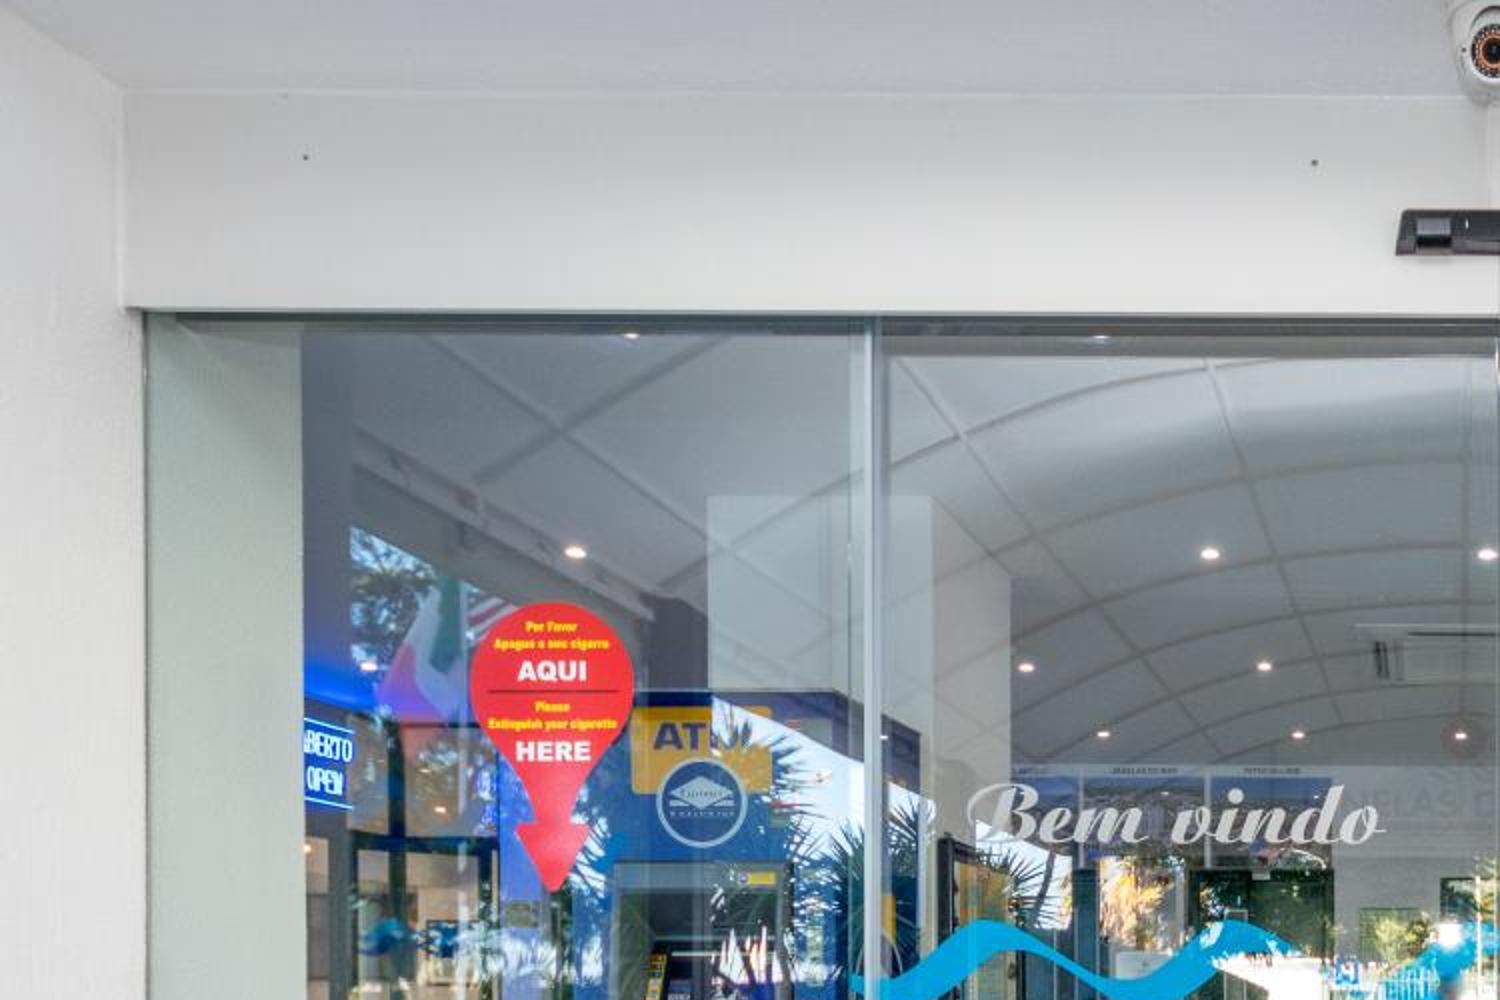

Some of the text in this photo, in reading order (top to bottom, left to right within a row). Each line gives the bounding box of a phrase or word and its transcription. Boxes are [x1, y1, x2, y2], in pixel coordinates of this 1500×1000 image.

[517, 660, 588, 682] AQUI
[515, 740, 592, 763] HERE
[307, 765, 344, 796] OPEN
[967, 783, 1387, 845] Bem vindo
